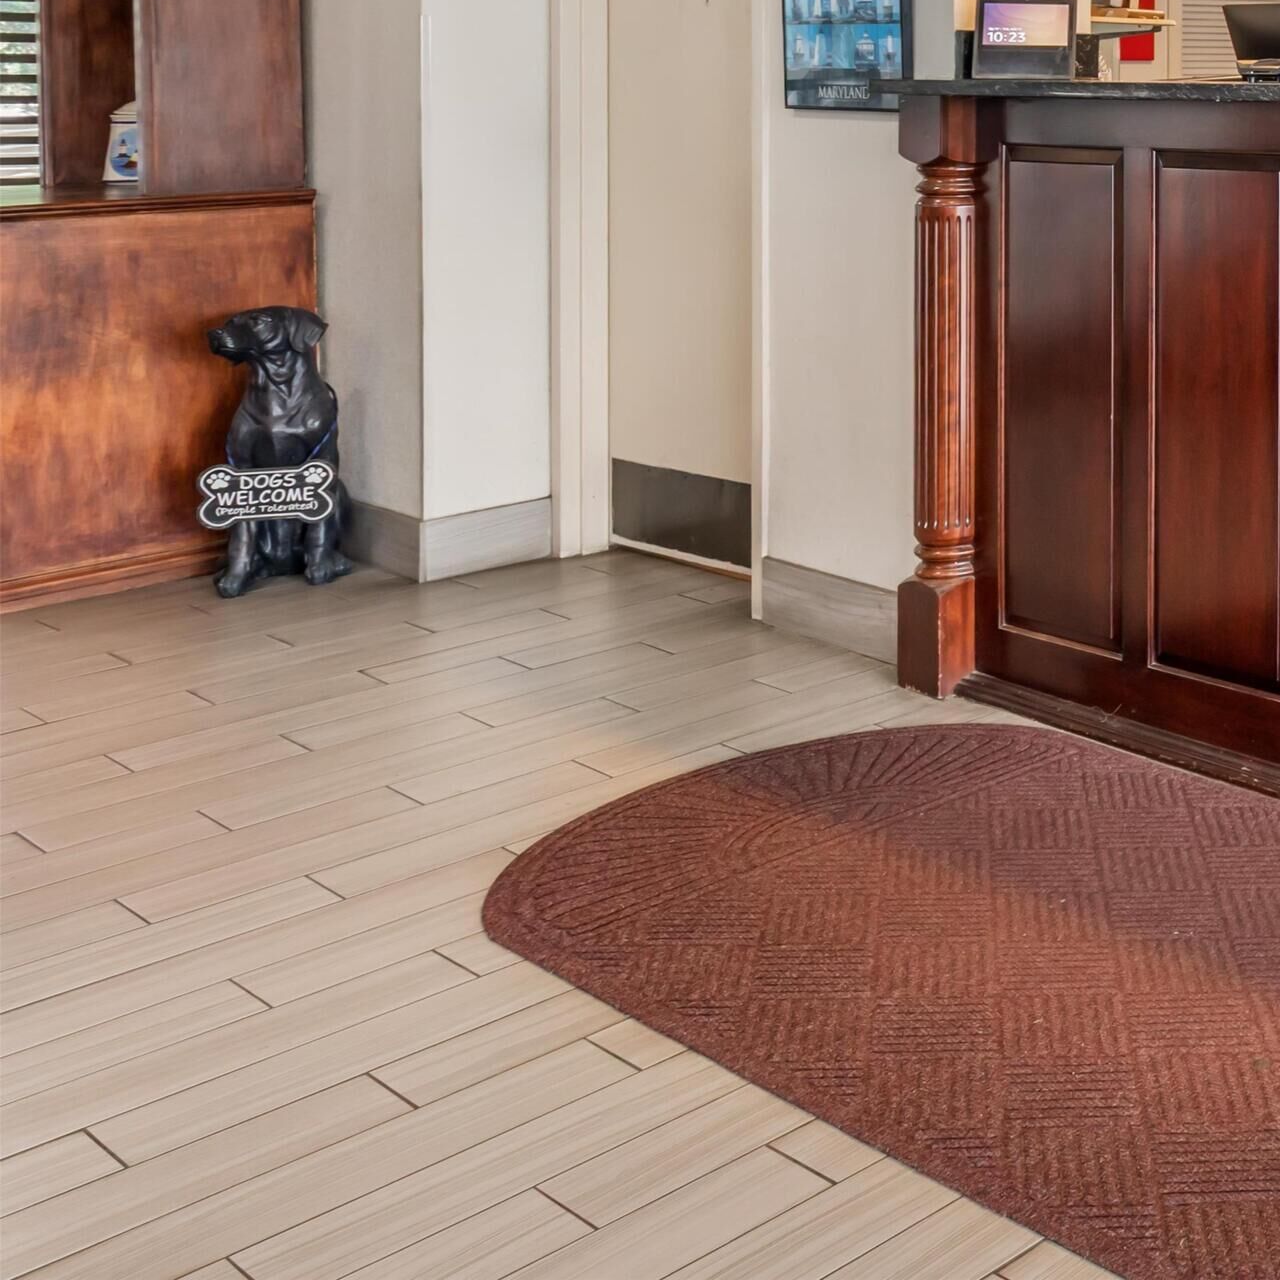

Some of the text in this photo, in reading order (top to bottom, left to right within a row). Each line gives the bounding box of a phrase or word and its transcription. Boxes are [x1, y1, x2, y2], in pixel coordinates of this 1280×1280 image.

[987, 32, 1026, 42] 10:23
[818, 86, 870, 99] MARYLAND
[240, 473, 296, 490] DOGS
[217, 486, 315, 506] WELCOME
[216, 501, 319, 516] (People Tolerated)
